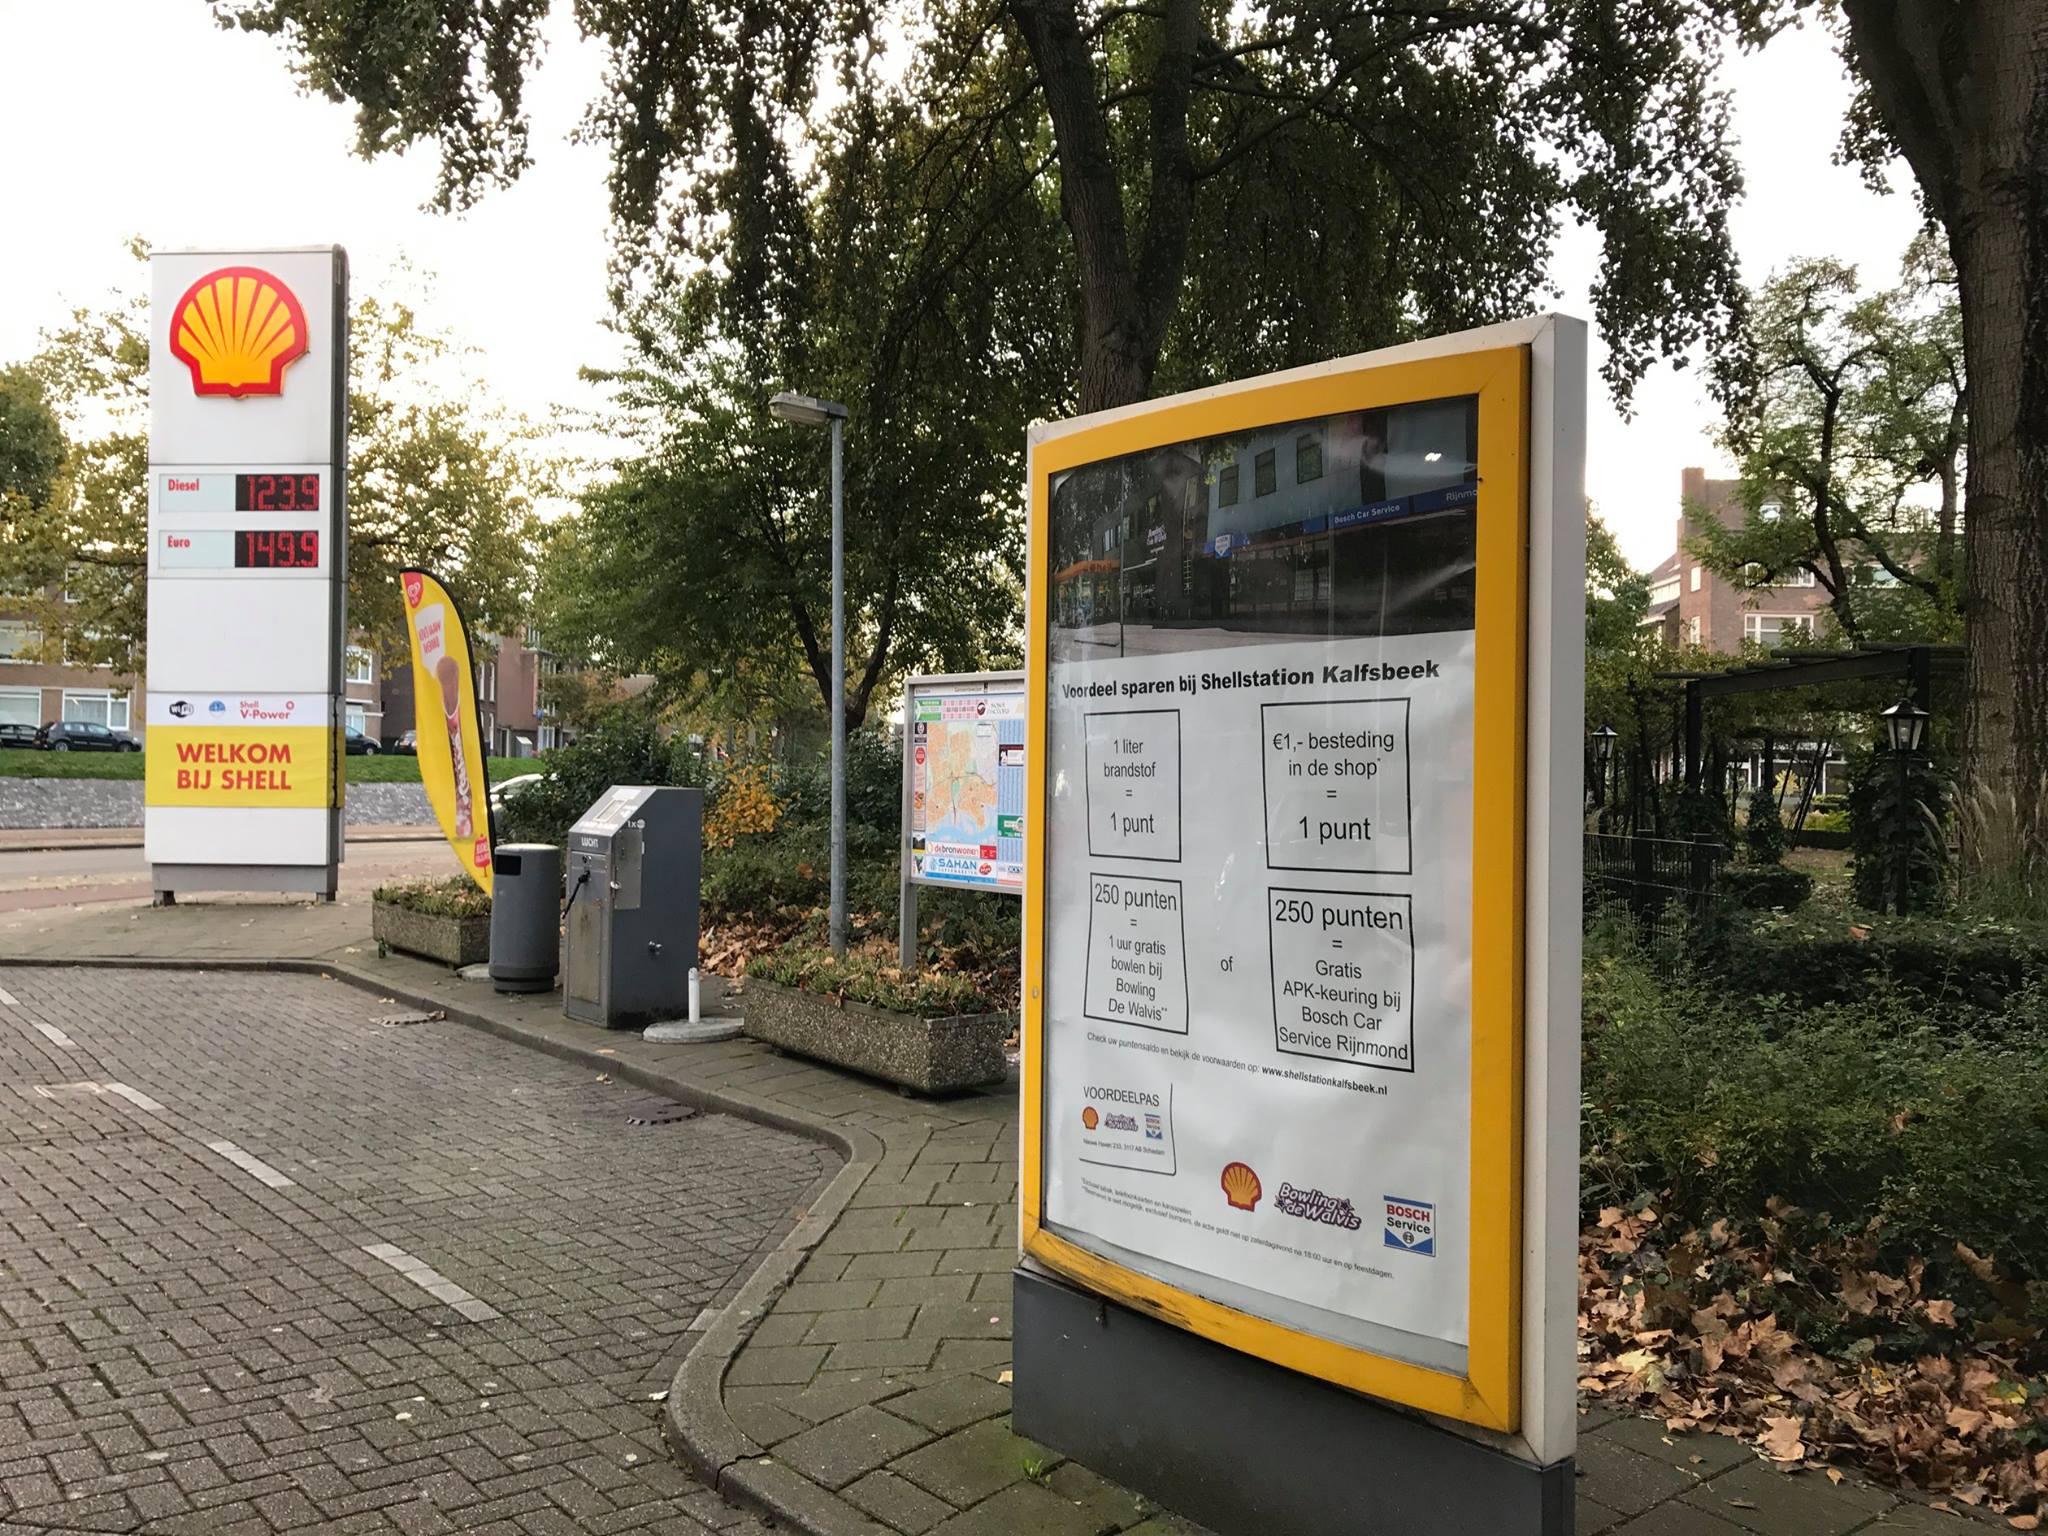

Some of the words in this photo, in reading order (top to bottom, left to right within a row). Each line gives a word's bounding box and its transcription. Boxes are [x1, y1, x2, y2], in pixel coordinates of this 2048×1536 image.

[168, 478, 200, 491] Diesel
[1356, 509, 1370, 519] Car
[1371, 504, 1401, 516] Service
[167, 535, 191, 548] Euro
[1062, 681, 1117, 699] Voordeel
[1121, 677, 1175, 698] sparen
[1179, 674, 1197, 693] bij
[1201, 668, 1315, 691] Shellstation
[1322, 660, 1440, 684] Kalfsbeek
[240, 701, 260, 709] Shell
[240, 709, 291, 720] V-Power
[1113, 739, 1119, 753] 1
[1122, 740, 1144, 754] liter
[1272, 732, 1304, 751] €1,-
[1308, 732, 1395, 753] besteding
[176, 743, 291, 764] WELKOM
[1103, 761, 1156, 777] brandstof
[1288, 760, 1303, 776] in
[1307, 758, 1329, 775] de
[177, 769, 212, 789] BIJ
[221, 770, 291, 790] SHELL
[1110, 812, 1118, 832] 1
[1122, 813, 1155, 837] punt
[1299, 817, 1309, 838] 1
[1319, 818, 1372, 845] punt
[939, 858, 977, 869] SAHAN
[1095, 883, 1120, 904] 250
[1124, 887, 1178, 911] punten
[1275, 899, 1314, 925] 250
[1322, 904, 1403, 931] punten
[1109, 935, 1114, 949] 1
[1117, 938, 1132, 951] uur
[1134, 937, 1167, 956] gratis
[1111, 956, 1145, 974] bowlen
[1148, 960, 1163, 980] bij
[1220, 957, 1234, 972] of
[1315, 959, 1362, 979] Gratis
[1116, 977, 1156, 1000] Bowling
[1283, 980, 1378, 1008] APK-keuring
[1383, 991, 1402, 1012] bij
[1108, 998, 1125, 1014] De
[1302, 1005, 1348, 1027] Bosch
[1353, 1012, 1382, 1031] Car
[1279, 1025, 1332, 1049] Service
[1337, 1034, 1408, 1061] Rijnmond
[1087, 1031, 1106, 1043] Check
[1108, 1036, 1117, 1045] uw
[1119, 1039, 1159, 1054] puntensaldo
[1161, 1047, 1169, 1055] en
[1170, 1048, 1190, 1060] bekijk
[1192, 1052, 1200, 1062] de
[1202, 1055, 1246, 1071] voorwaarden
[1248, 1063, 1260, 1074] op:
[1262, 1065, 1388, 1096] www.shellstationkalfsbeek.nl
[1083, 1086, 1160, 1107] VOORDEELPAS
[1281, 1183, 1337, 1211] Bowling
[1288, 1203, 1301, 1214] de
[1304, 1204, 1360, 1229] Walvis
[1387, 1204, 1431, 1222] BOSCH
[1387, 1216, 1431, 1234] Service
